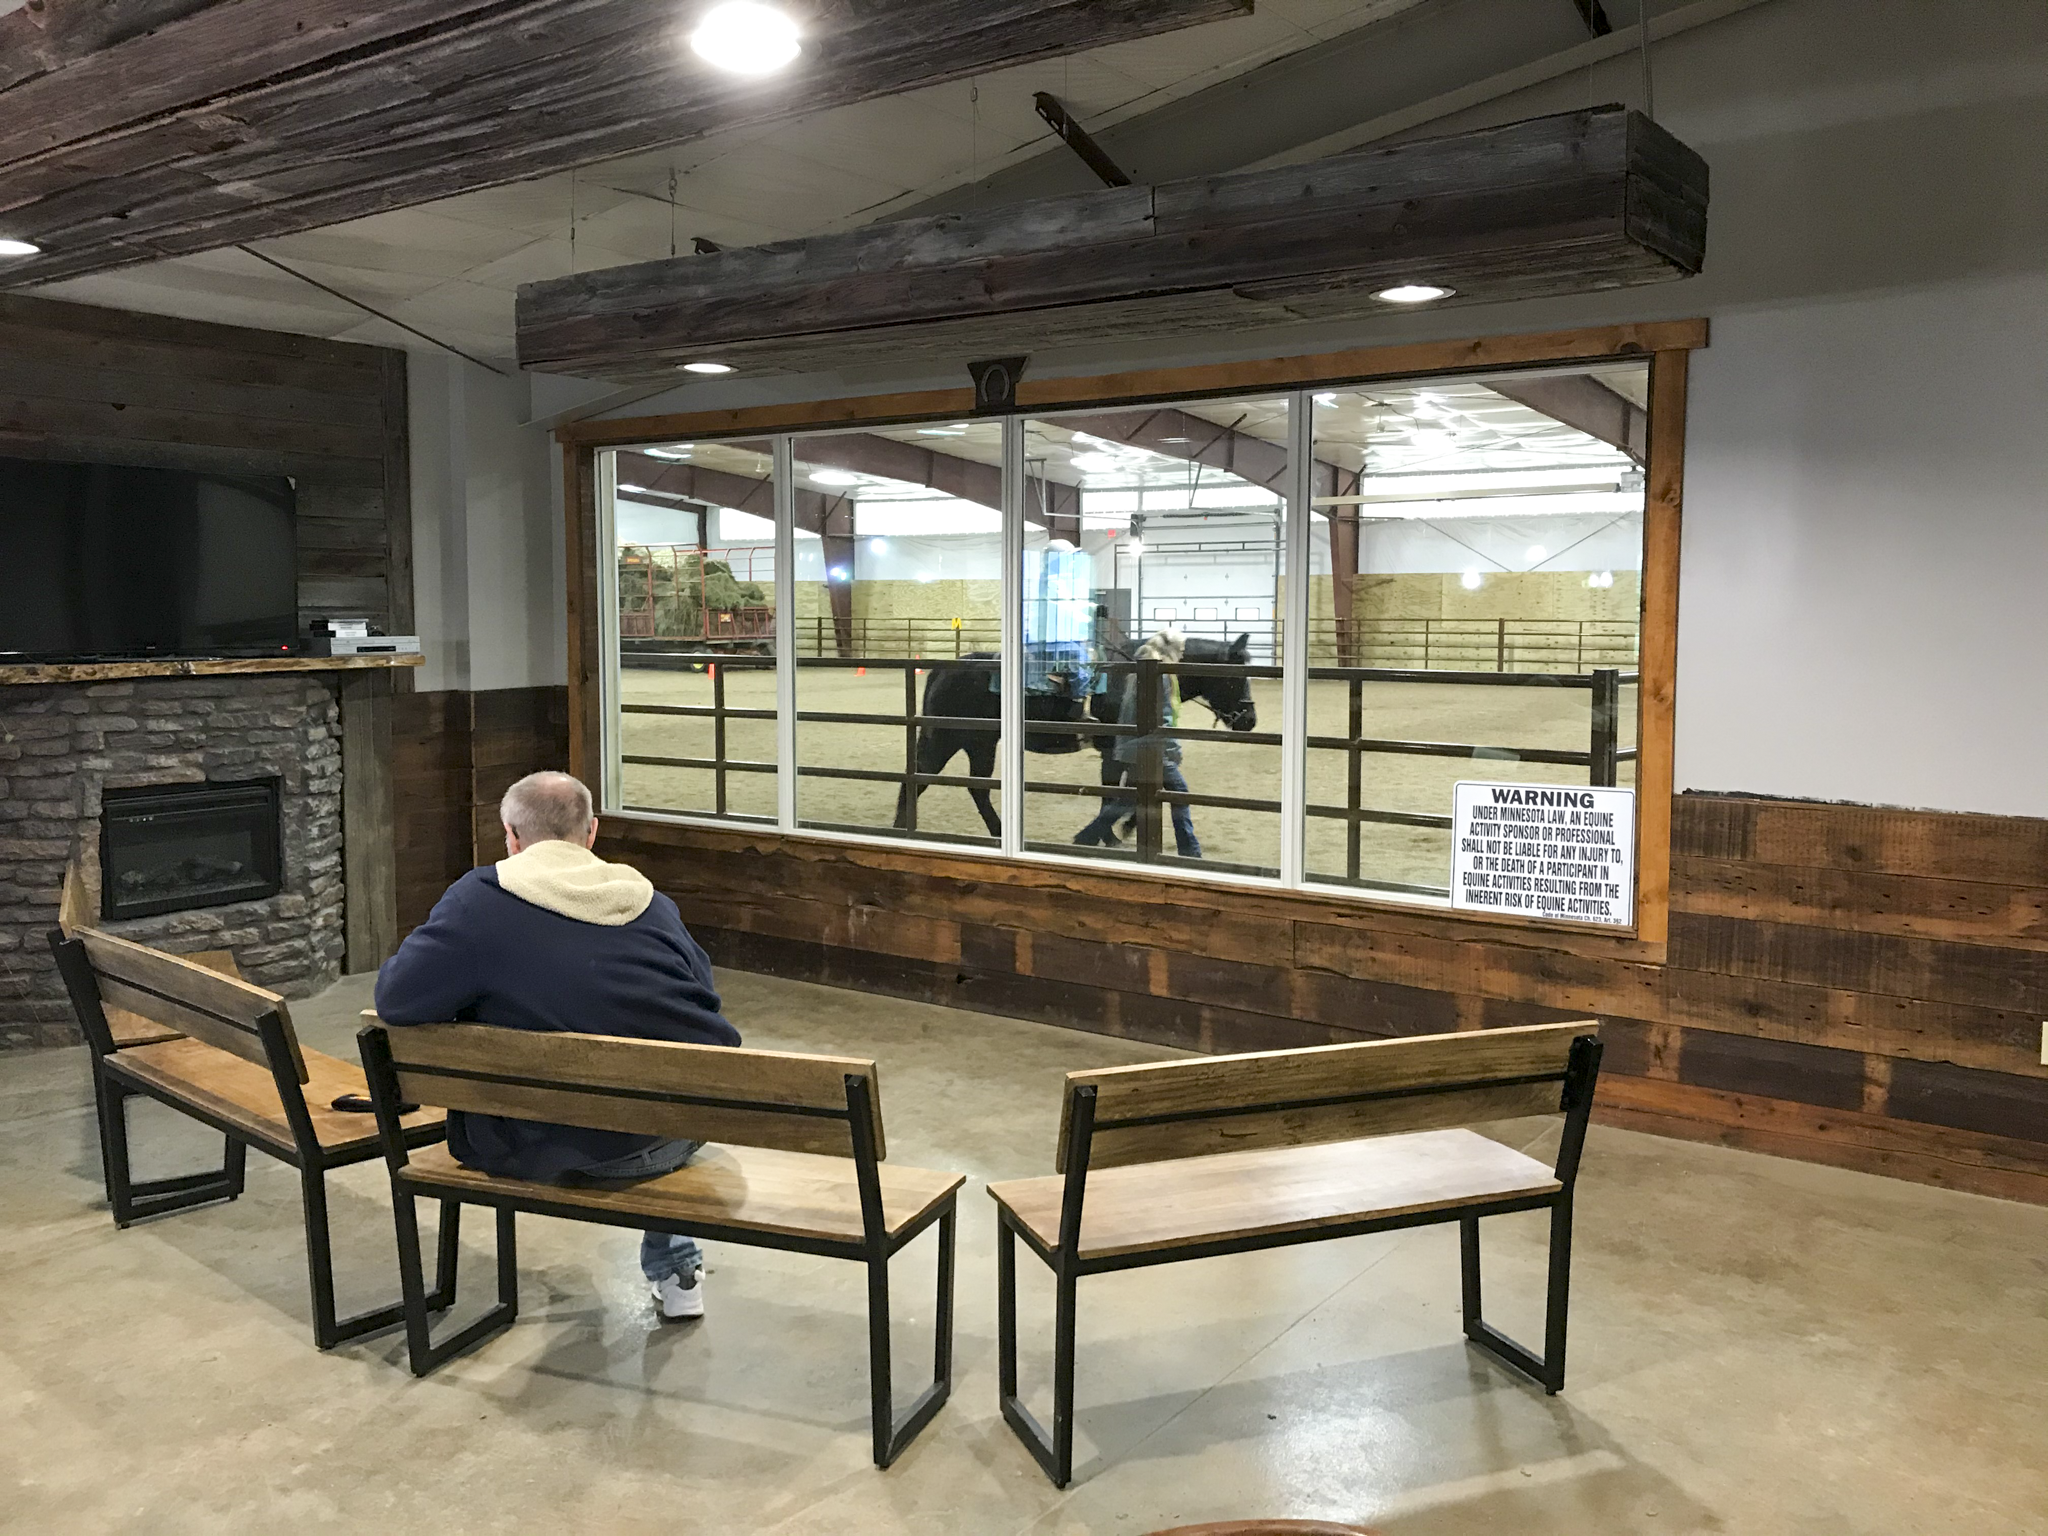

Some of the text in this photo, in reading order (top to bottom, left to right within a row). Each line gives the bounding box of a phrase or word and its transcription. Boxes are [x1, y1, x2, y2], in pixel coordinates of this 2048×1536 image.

[1491, 788, 1594, 809] WARNING
[1472, 805, 1614, 828] UNDER MINNESOTA LAW, AN EQUINE
[1469, 822, 1615, 845] ACTIVITY SPONSOR OR PROFESSIONAL
[1461, 838, 1623, 866] SHALL NOT BE LIABLE FOR ANY INJURY TO,
[1473, 855, 1610, 880] OR THE DEATH OF A PARTICIPANT IN
[1463, 871, 1620, 899] EQUINE ACTIVITIES RESULTING FROM THE
[1465, 888, 1612, 916] INHERENT RISK OF EQUINE ACTIVITIES.
[1560, 913, 1583, 921] Minnesota
